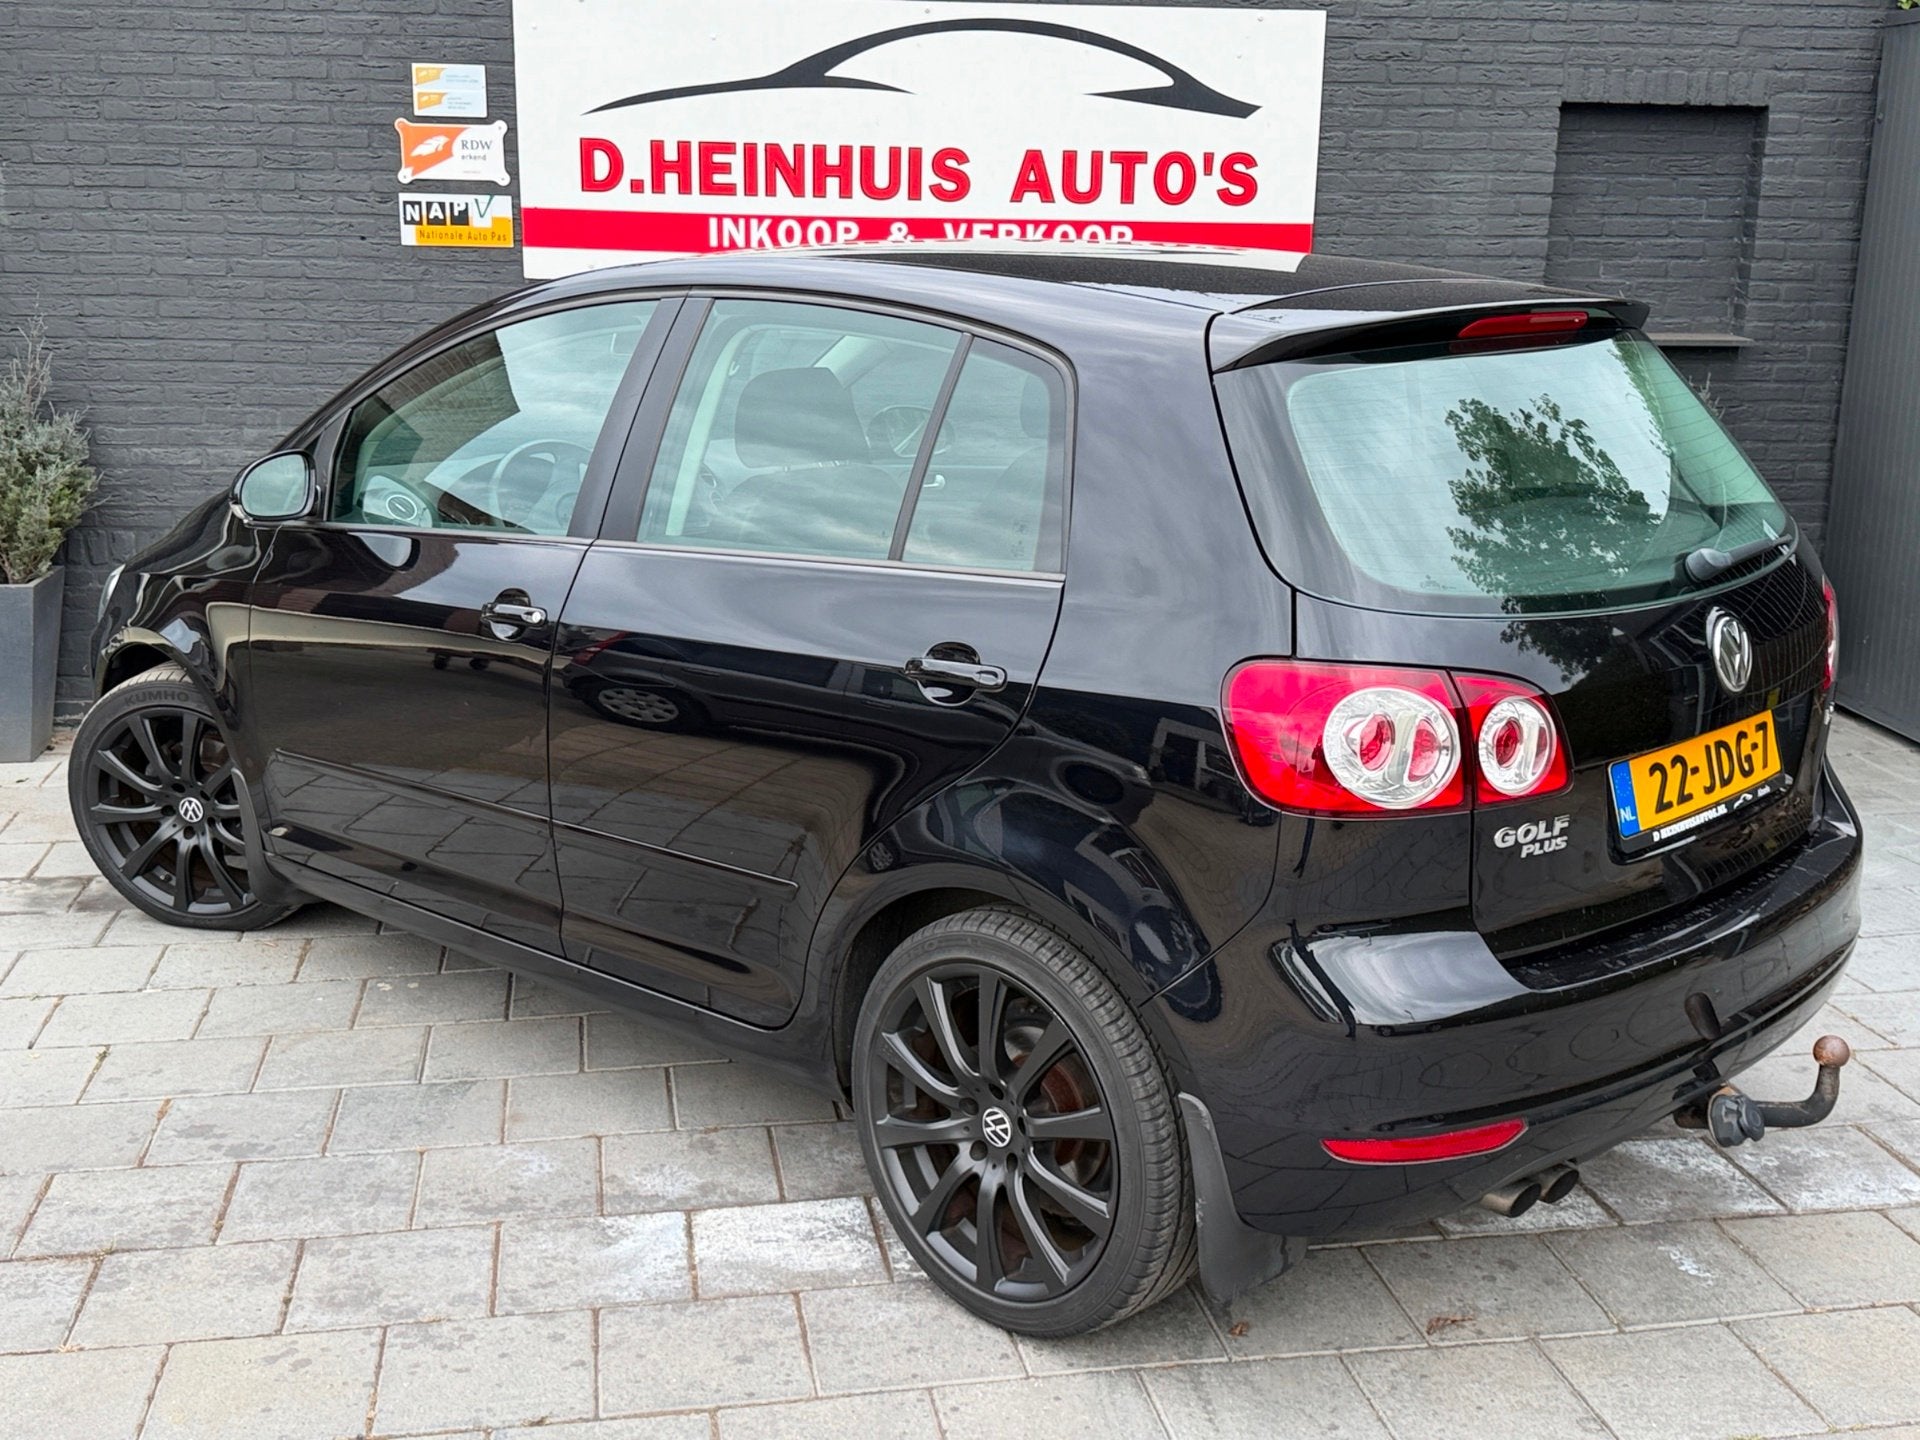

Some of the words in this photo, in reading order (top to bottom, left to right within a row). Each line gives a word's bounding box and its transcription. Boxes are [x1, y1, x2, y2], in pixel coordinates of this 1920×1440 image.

[461, 139, 493, 151] RDW
[580, 137, 971, 202] D.HEINHUIS
[1009, 149, 1259, 206] AUTO'S
[419, 230, 463, 240] Nationale
[467, 231, 488, 241] Auto
[491, 231, 507, 242] Pas
[708, 217, 860, 249] INKOOP
[887, 222, 914, 241] &
[124, 689, 189, 705] KUMHO
[1648, 720, 1768, 815] 22-JDG-7
[1620, 806, 1636, 823] NL
[1493, 814, 1571, 849] GOLF
[1520, 835, 1568, 858] PLUS
